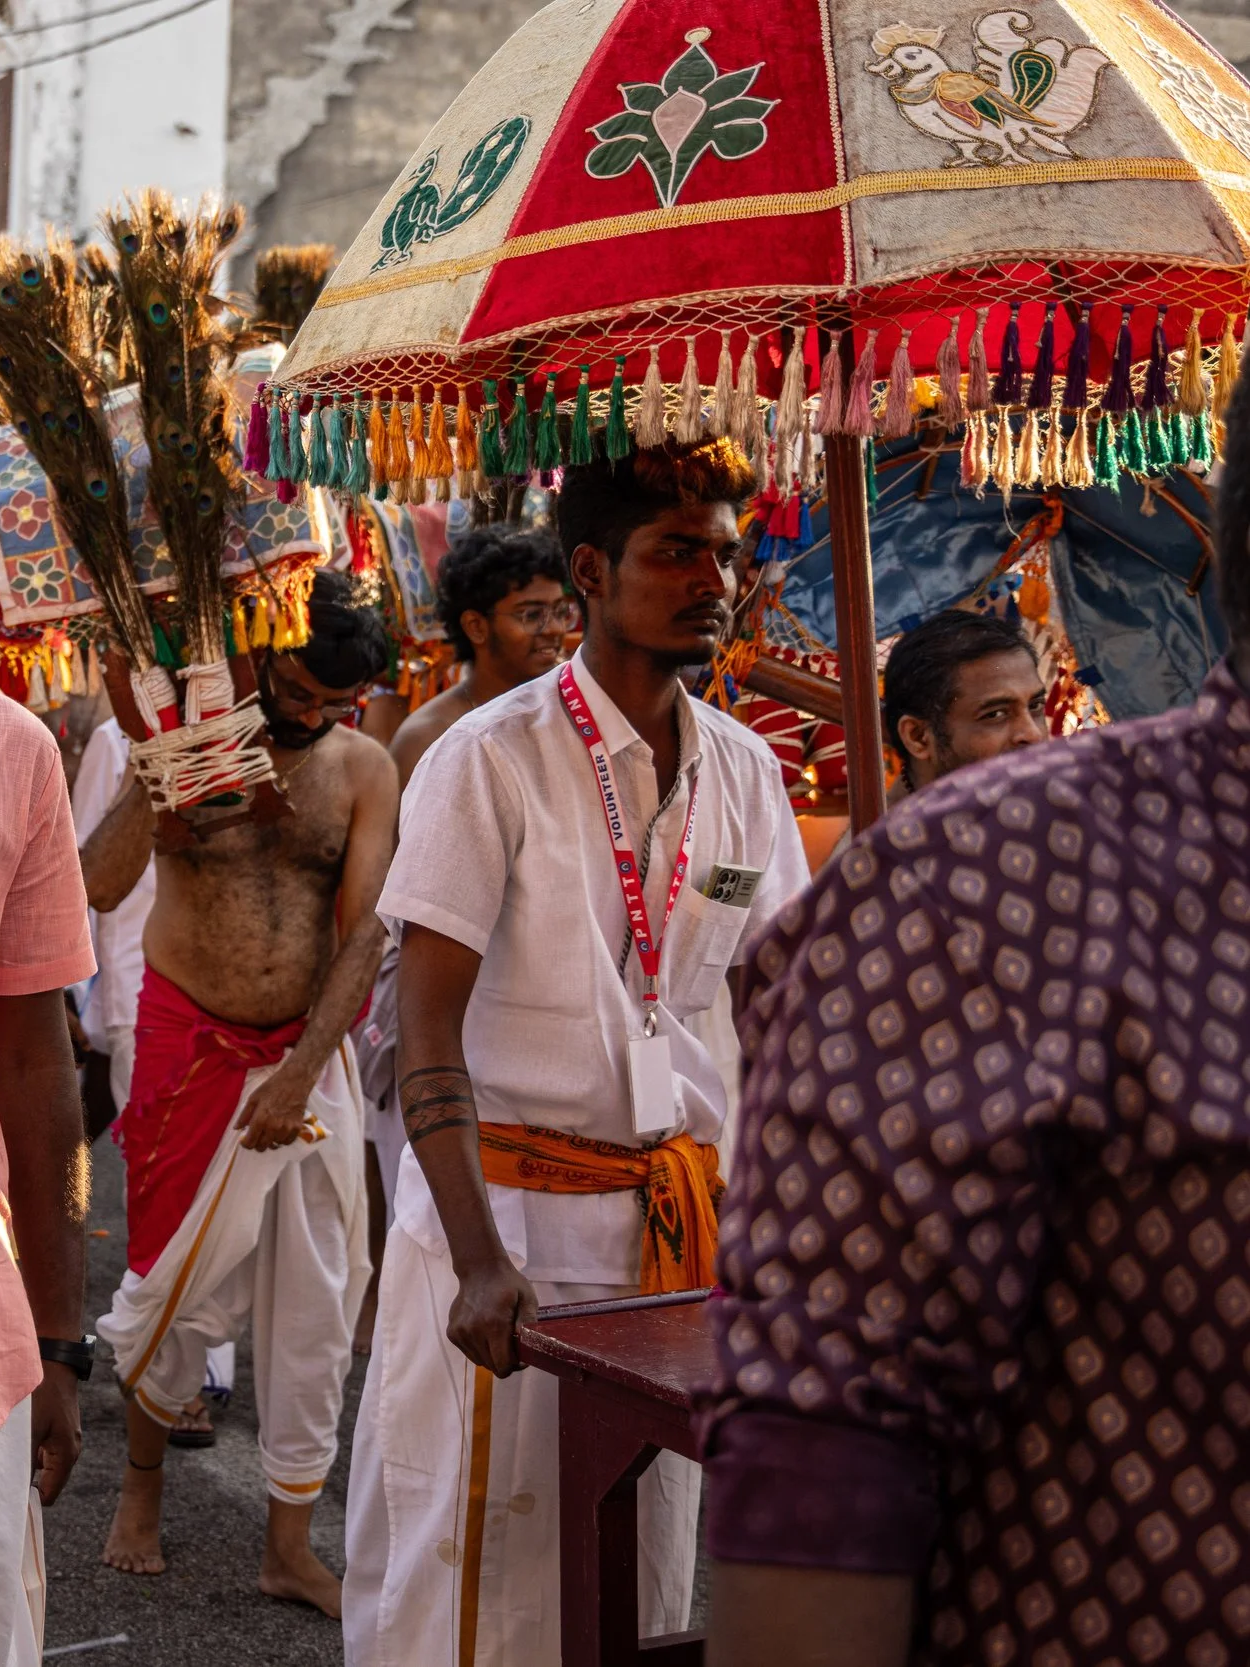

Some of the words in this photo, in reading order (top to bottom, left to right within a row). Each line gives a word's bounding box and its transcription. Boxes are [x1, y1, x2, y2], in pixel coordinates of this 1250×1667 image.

[558, 674, 589, 724] PNTT
[596, 754, 623, 841] VOLUNTEER
[622, 877, 648, 938] PNTT
